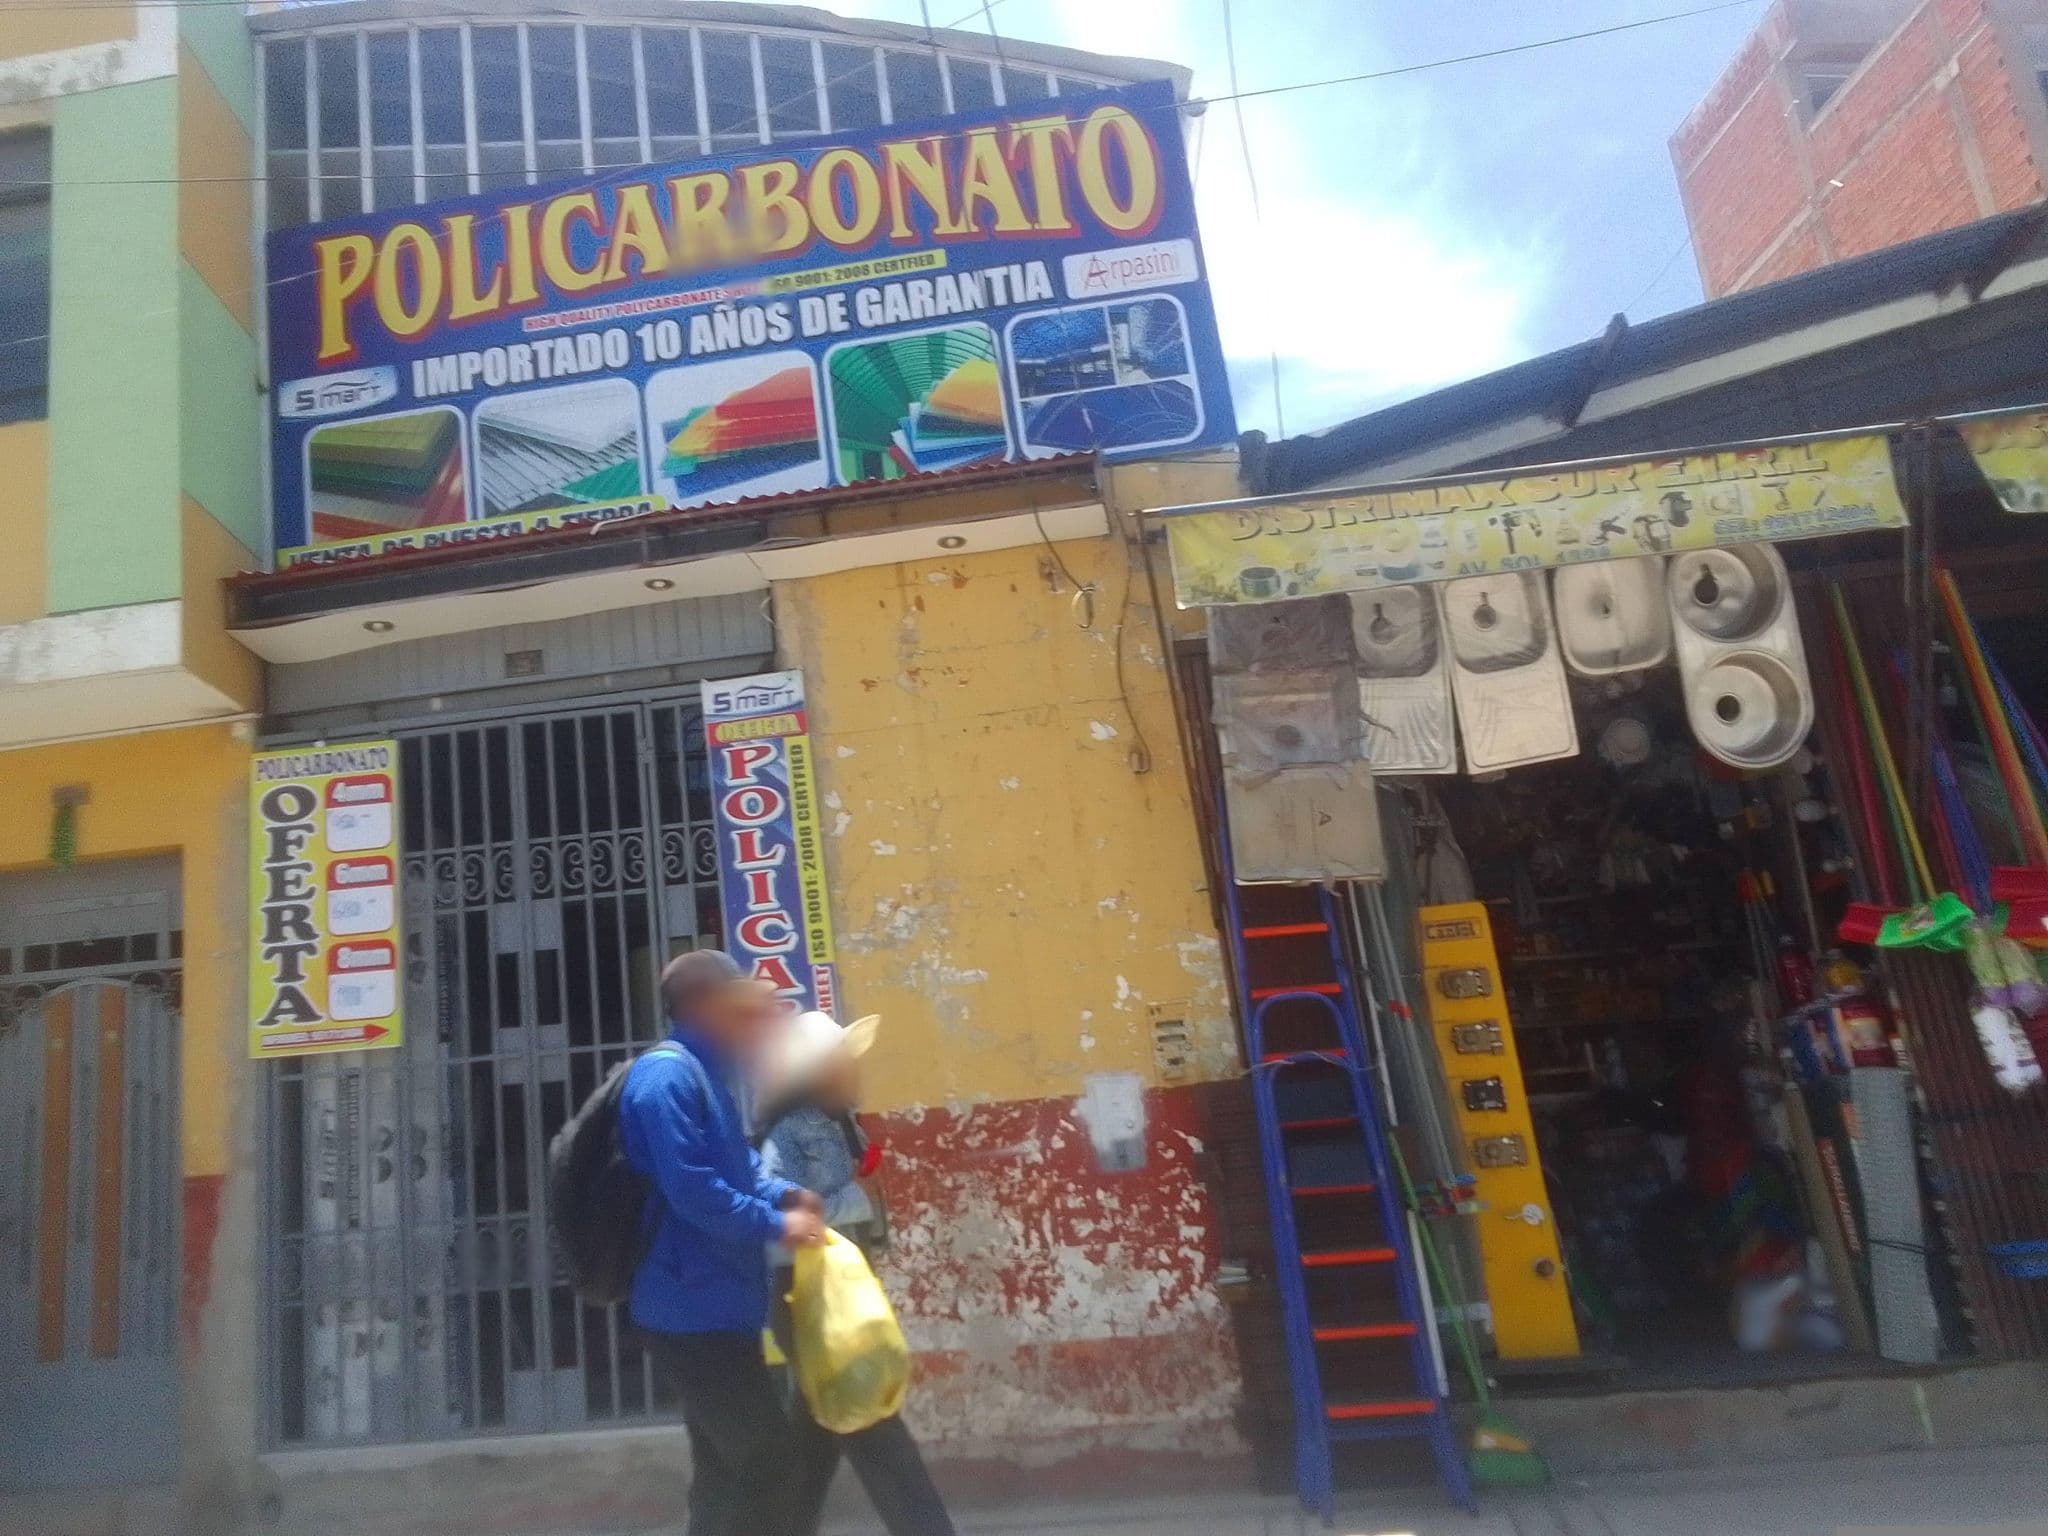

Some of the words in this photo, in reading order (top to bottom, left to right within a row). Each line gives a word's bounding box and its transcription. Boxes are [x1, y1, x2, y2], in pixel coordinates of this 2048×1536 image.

[315, 106, 1158, 361] POLICARBONATO
[412, 331, 631, 398] IMPORTADO
[638, 320, 678, 363] 10
[689, 303, 793, 355] AÑOS
[799, 297, 851, 338] DE
[855, 260, 1055, 328] GARANTIA
[560, 307, 612, 326] QUALITY
[255, 747, 389, 781] POLICARBONATO
[722, 744, 802, 1010] POLICA
[801, 823, 820, 872] 2008
[257, 784, 323, 1026] OFERTA
[811, 932, 827, 960] ISO
